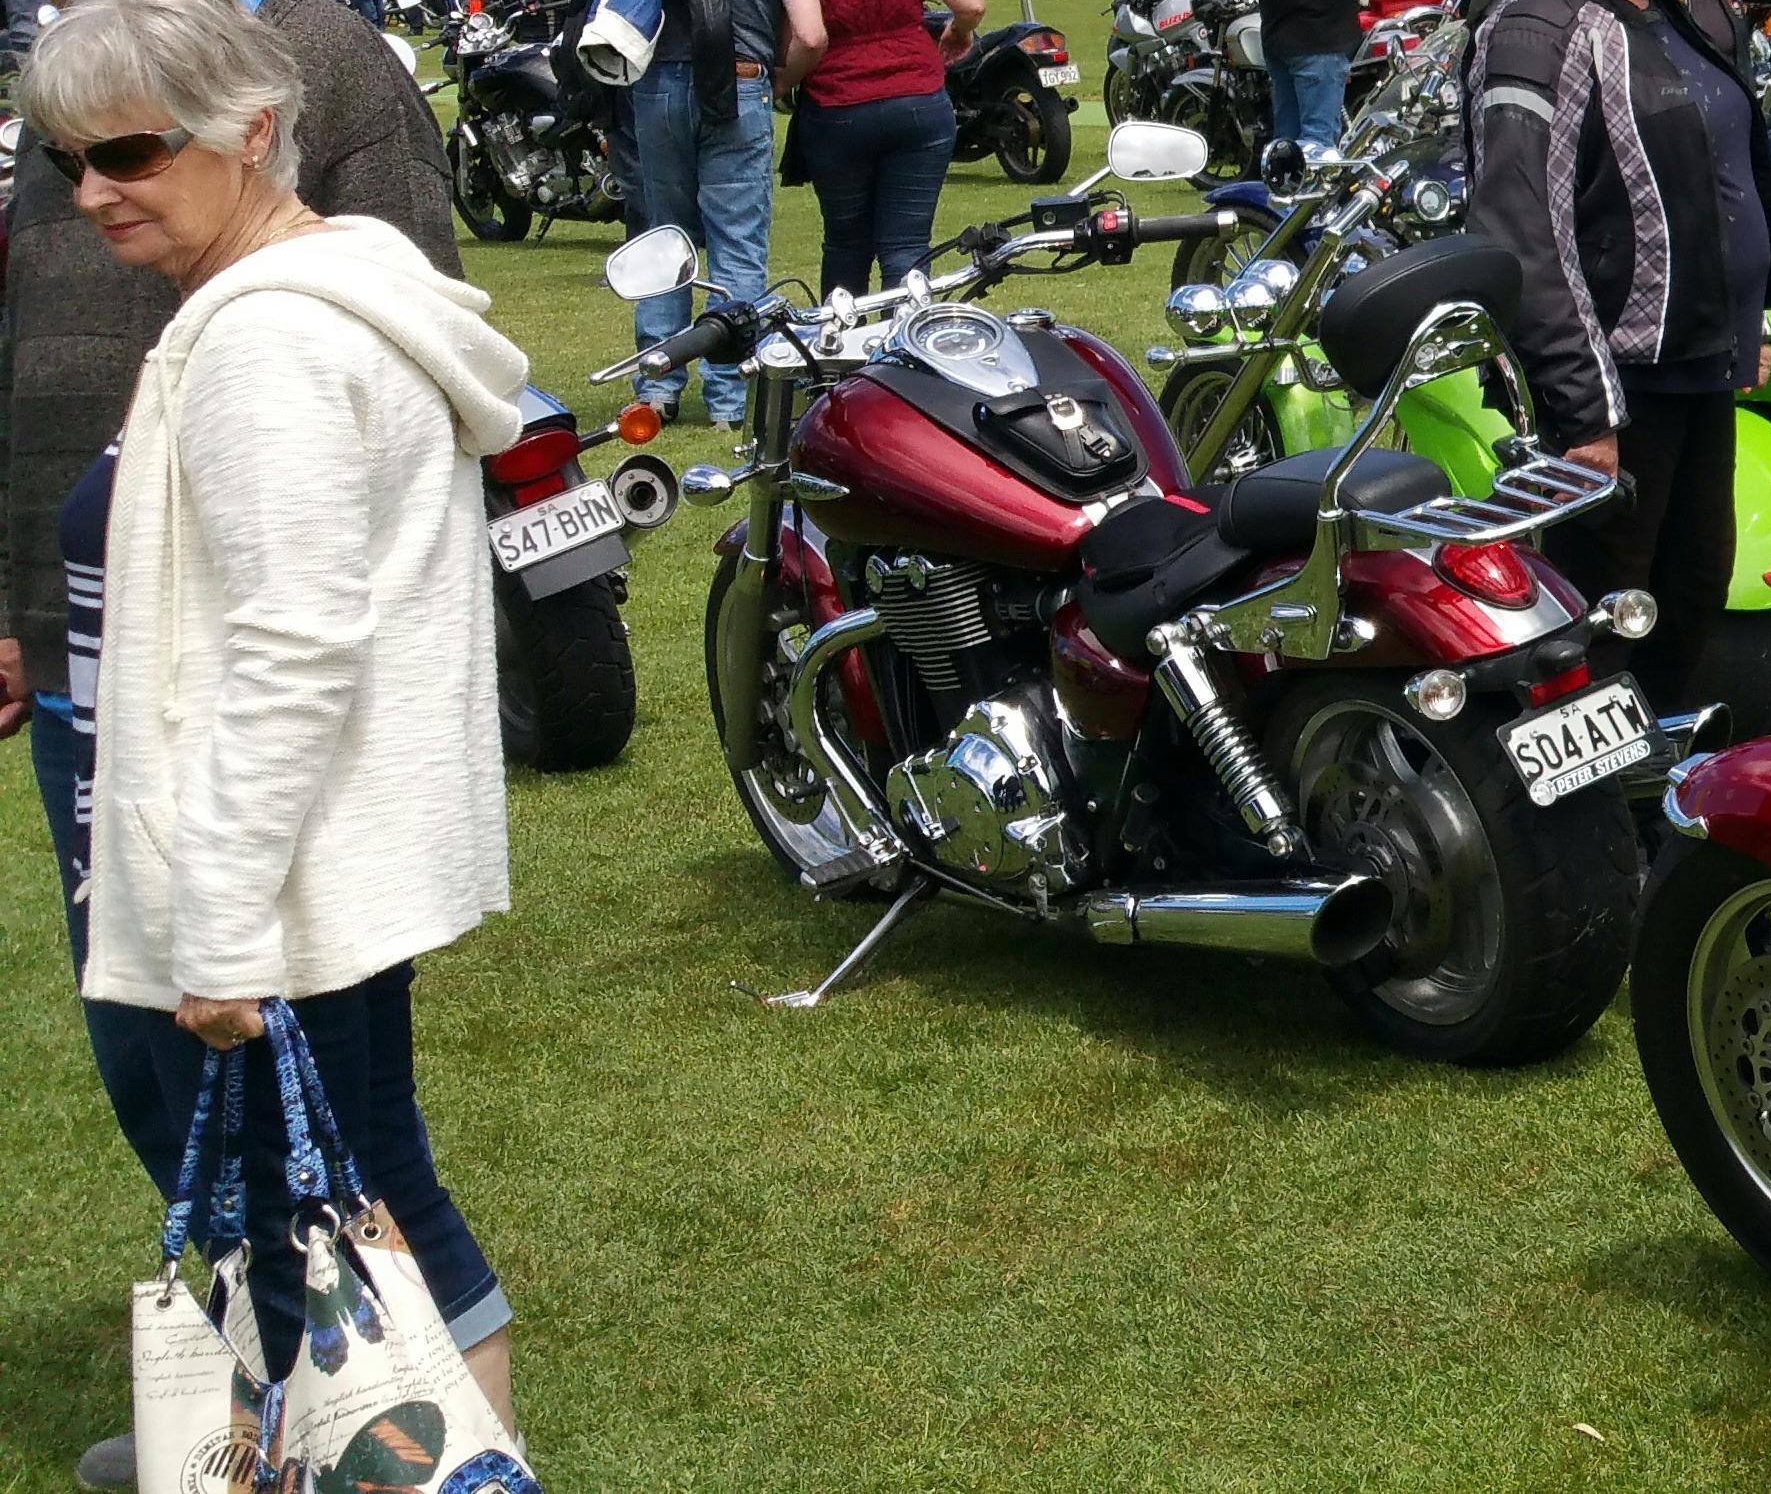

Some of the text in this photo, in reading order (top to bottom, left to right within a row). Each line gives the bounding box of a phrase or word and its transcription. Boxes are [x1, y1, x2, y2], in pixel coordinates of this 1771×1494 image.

[537, 504, 559, 516] SA
[1560, 704, 1582, 718] SA
[1557, 742, 1646, 793] PETER STEVENS
